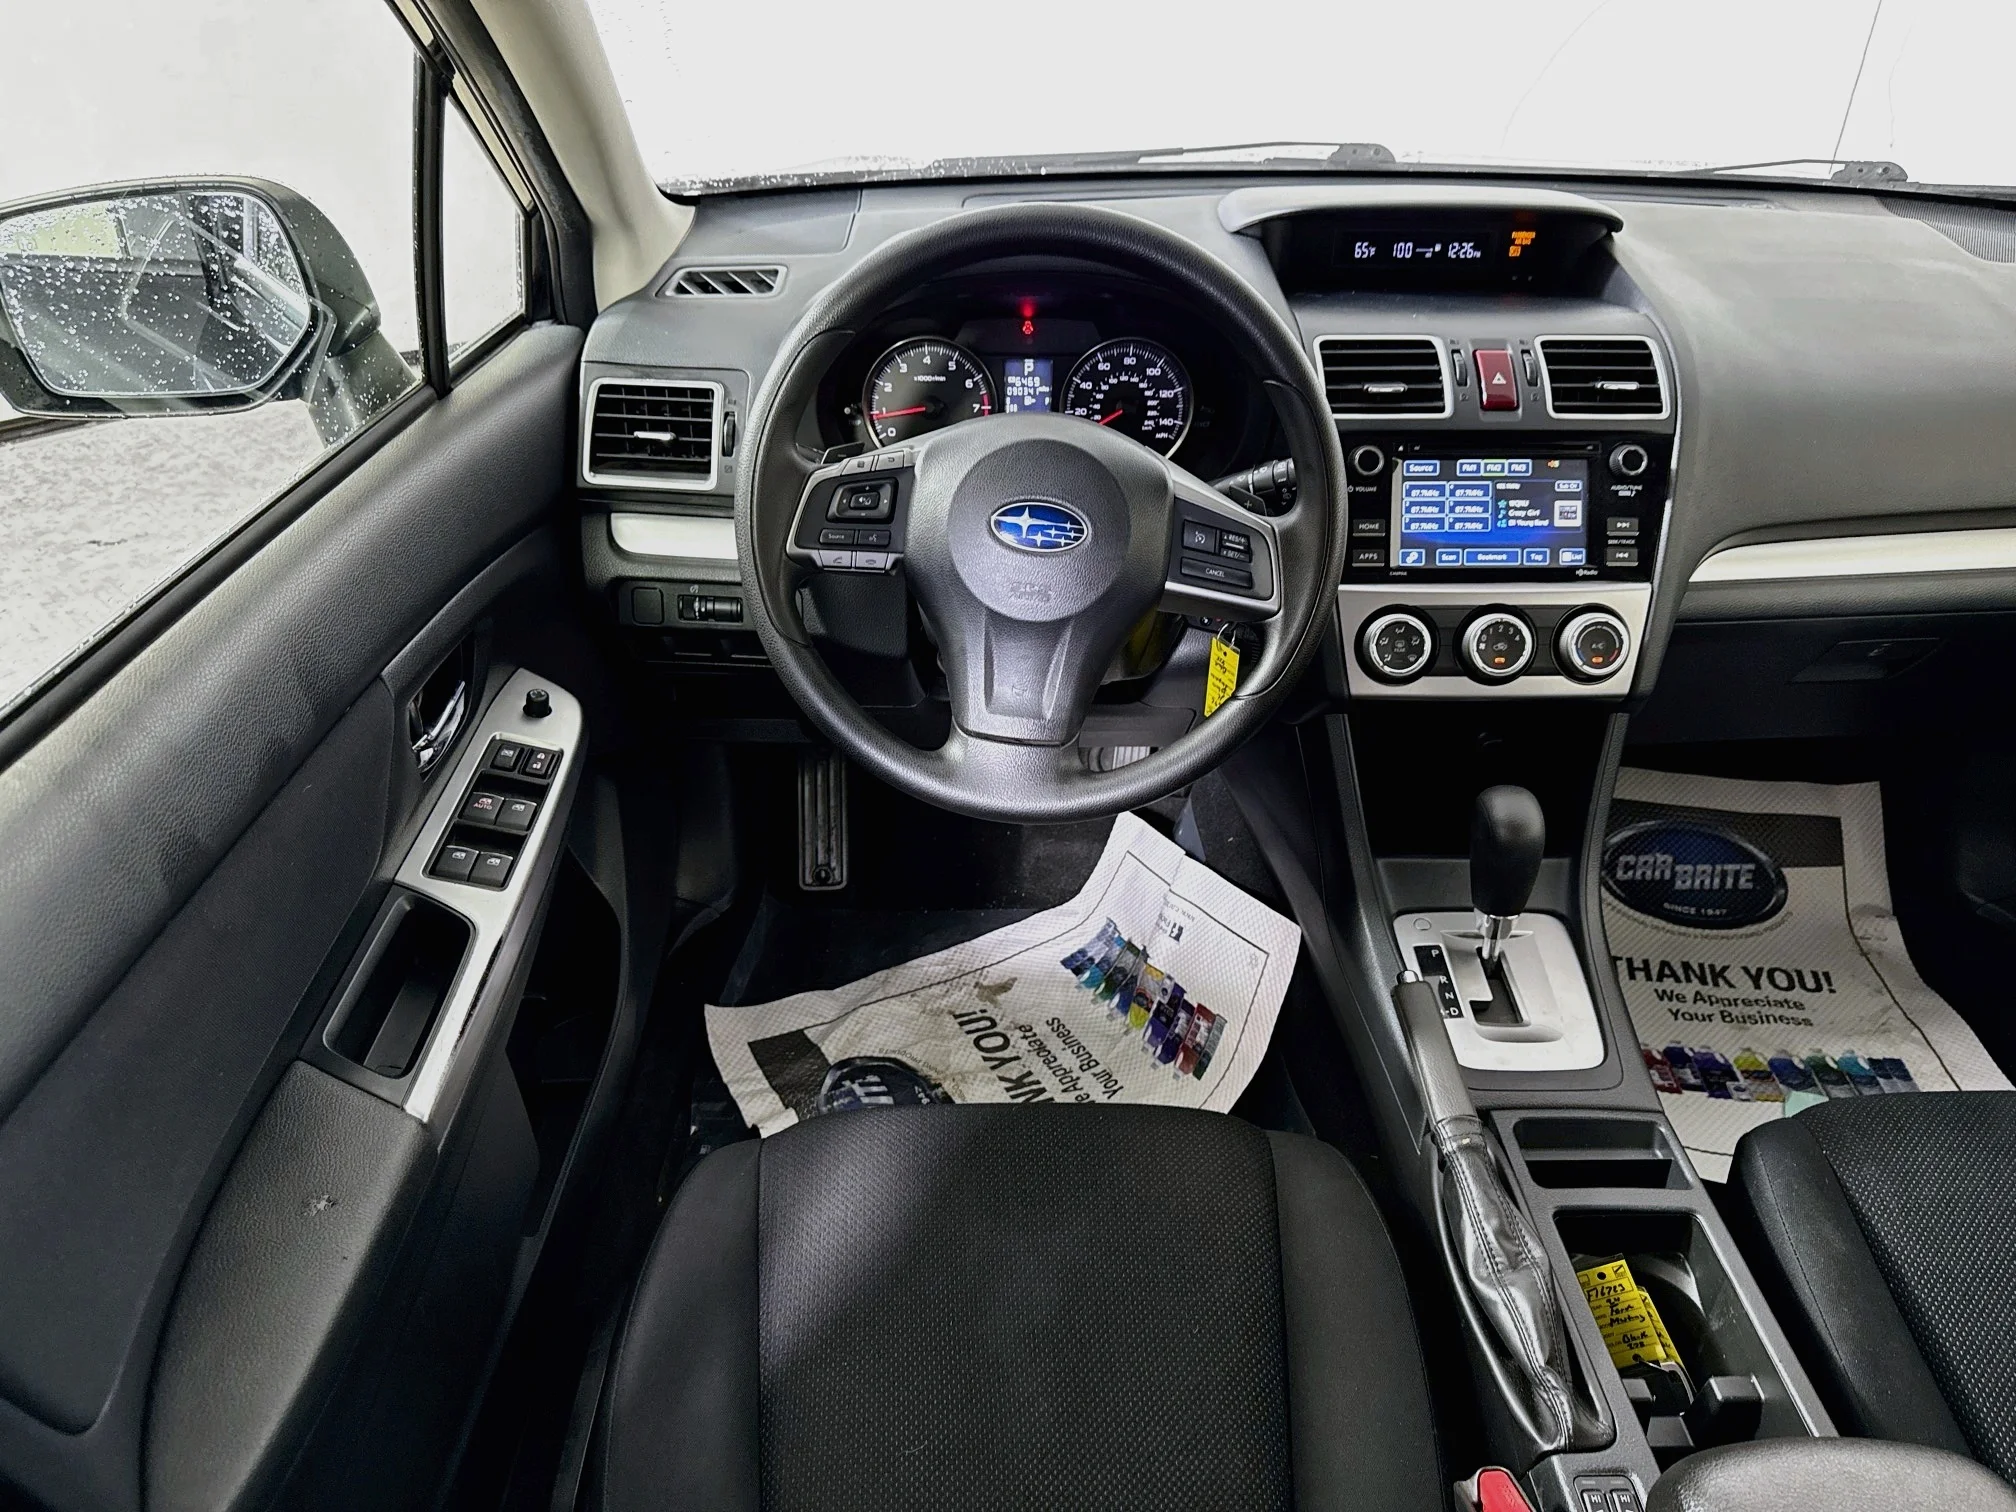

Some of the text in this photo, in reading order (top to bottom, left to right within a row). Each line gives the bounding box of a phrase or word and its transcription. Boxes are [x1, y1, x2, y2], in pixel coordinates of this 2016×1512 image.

[923, 356, 931, 364] 4
[1124, 357, 1136, 365] 80
[900, 364, 908, 372] 3
[948, 362, 956, 370] 5
[1098, 362, 1110, 370] 60
[884, 382, 892, 392] 2
[965, 379, 974, 388] 6
[1159, 390, 1174, 398] 120
[972, 404, 980, 413] 7
[887, 428, 896, 437] 0
[1409, 464, 1434, 472] Source
[1478, 553, 1507, 561] Bookmark
[1530, 554, 1544, 562] Tag
[1206, 568, 1224, 578] CANCEL
[1498, 624, 1504, 632] 2
[474, 802, 492, 810] AUTO
[1615, 852, 1756, 890] CAR BRITE
[1663, 902, 1697, 915] SINCE
[1432, 950, 1440, 958] P
[1440, 976, 1448, 984] R
[1740, 965, 1837, 994] YOU!
[1654, 988, 1806, 1011] We Appreciate
[1668, 1008, 1814, 1027] Your Business
[952, 1009, 1022, 1071] YOU!
[1018, 1024, 1084, 1094] Appreciate
[1046, 1016, 1124, 1100] Your Business
[1590, 1494, 1602, 1504] HI
[1620, 1494, 1631, 1504] HI
